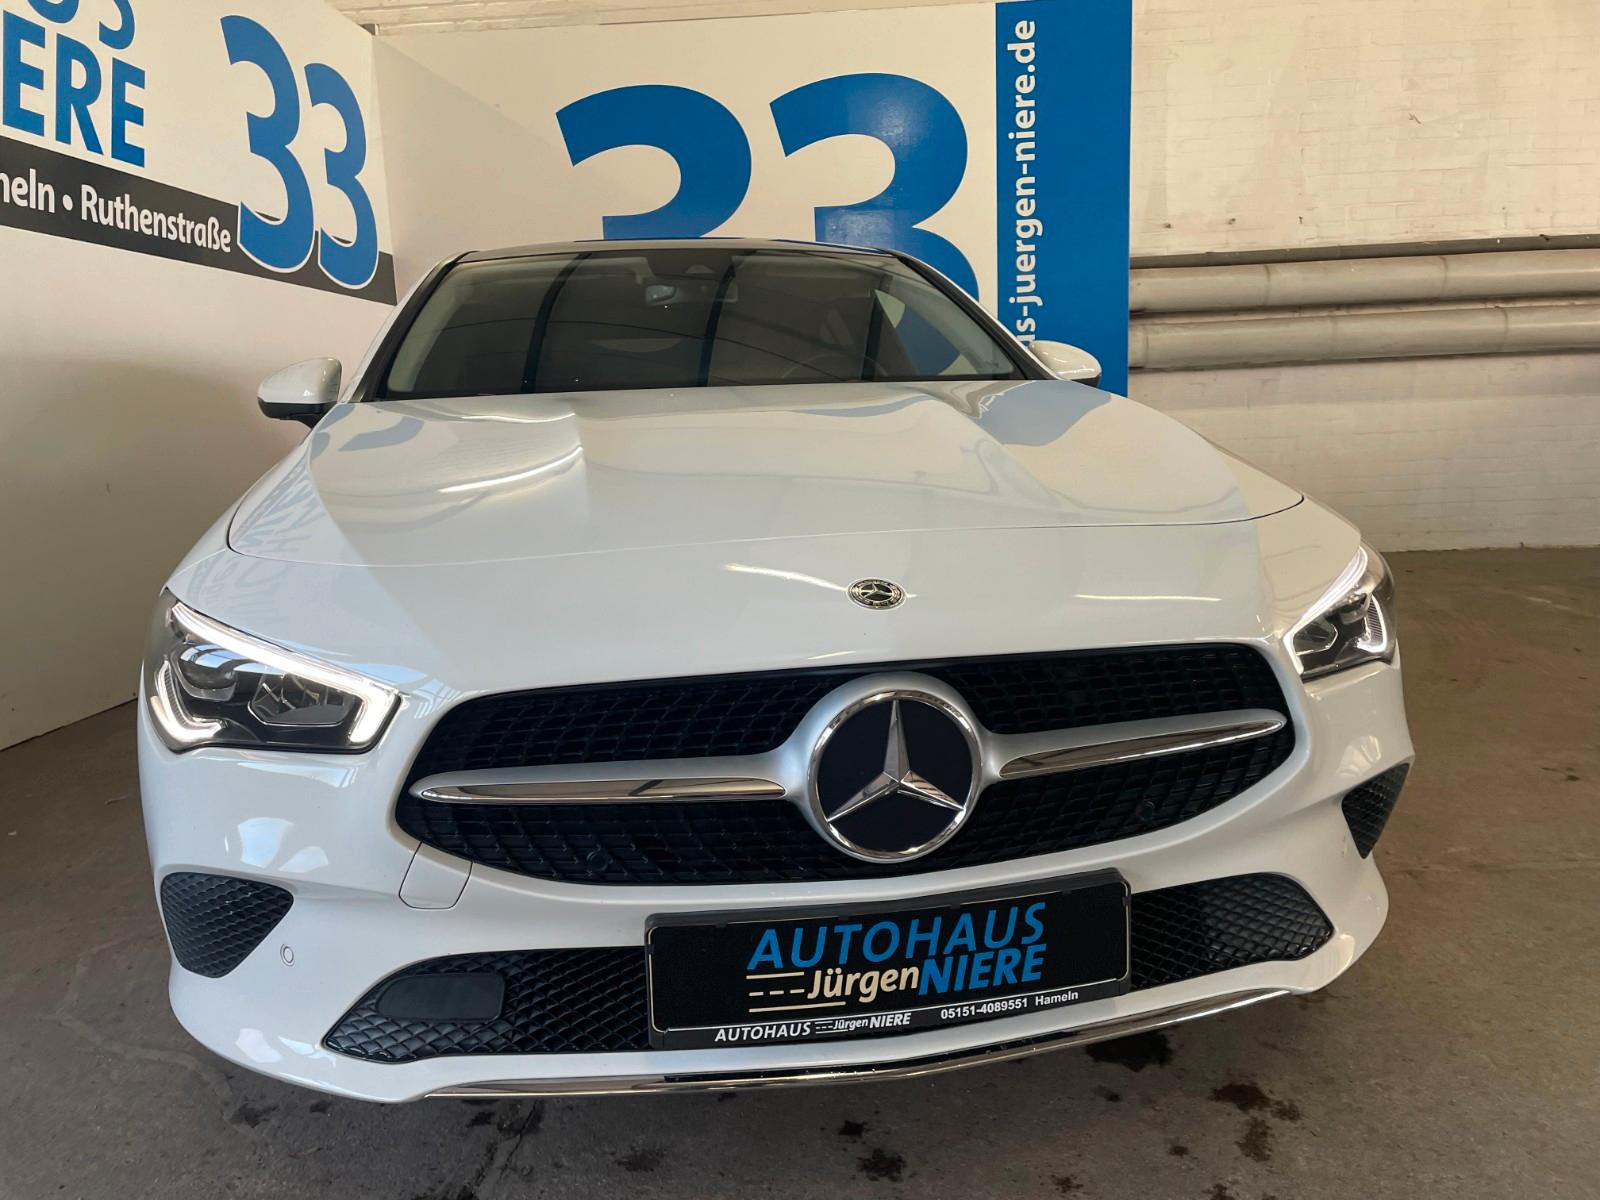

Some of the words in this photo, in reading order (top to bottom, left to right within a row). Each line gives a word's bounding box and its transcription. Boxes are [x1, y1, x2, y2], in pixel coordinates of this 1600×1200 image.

[81, 184, 232, 253] Ruthenstraße
[220, 14, 378, 290] 33
[746, 902, 1046, 970] AUTOHAUS
[807, 965, 920, 1003] Jürgen
[918, 943, 1047, 996] NIERE
[714, 1022, 811, 1042] AUTOHAUS
[832, 1017, 869, 1031] Jürgen
[869, 1012, 912, 1029] NIERE
[940, 997, 1028, 1019] 05151-4089551
[1035, 991, 1079, 1006] Hameln
